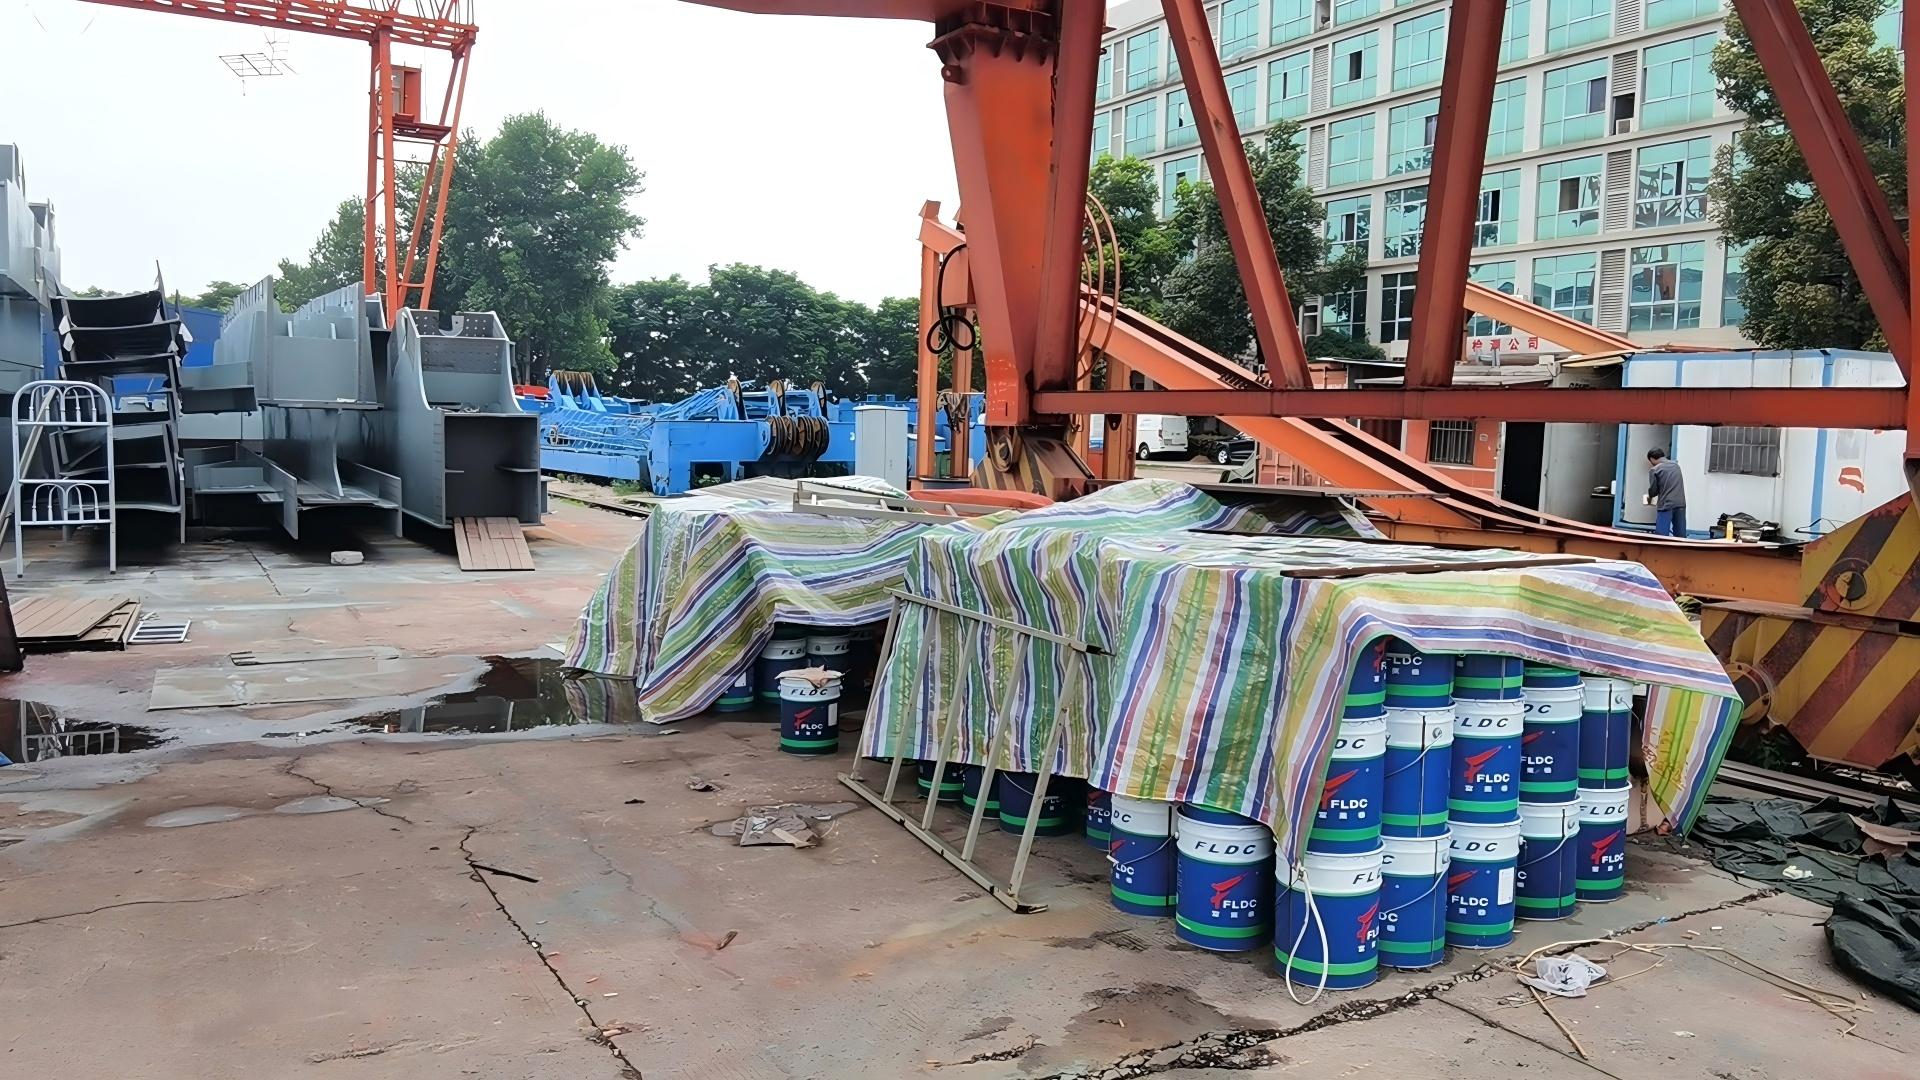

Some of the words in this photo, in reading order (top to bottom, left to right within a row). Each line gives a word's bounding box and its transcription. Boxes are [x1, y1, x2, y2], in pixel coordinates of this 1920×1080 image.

[781, 648, 806, 656] FLD
[790, 688, 829, 696] FLDC
[1524, 704, 1552, 714] DC
[1334, 738, 1366, 749] DC
[1476, 773, 1511, 783] FLDC
[1330, 798, 1369, 810] FLDC
[1113, 809, 1132, 823] DC
[1194, 841, 1257, 855] FLDC
[1449, 839, 1498, 852] LDC
[1601, 851, 1625, 864] FLDC
[1222, 899, 1258, 909] FLDC
[1451, 894, 1489, 907] FLDC
[1378, 911, 1399, 922] DC
